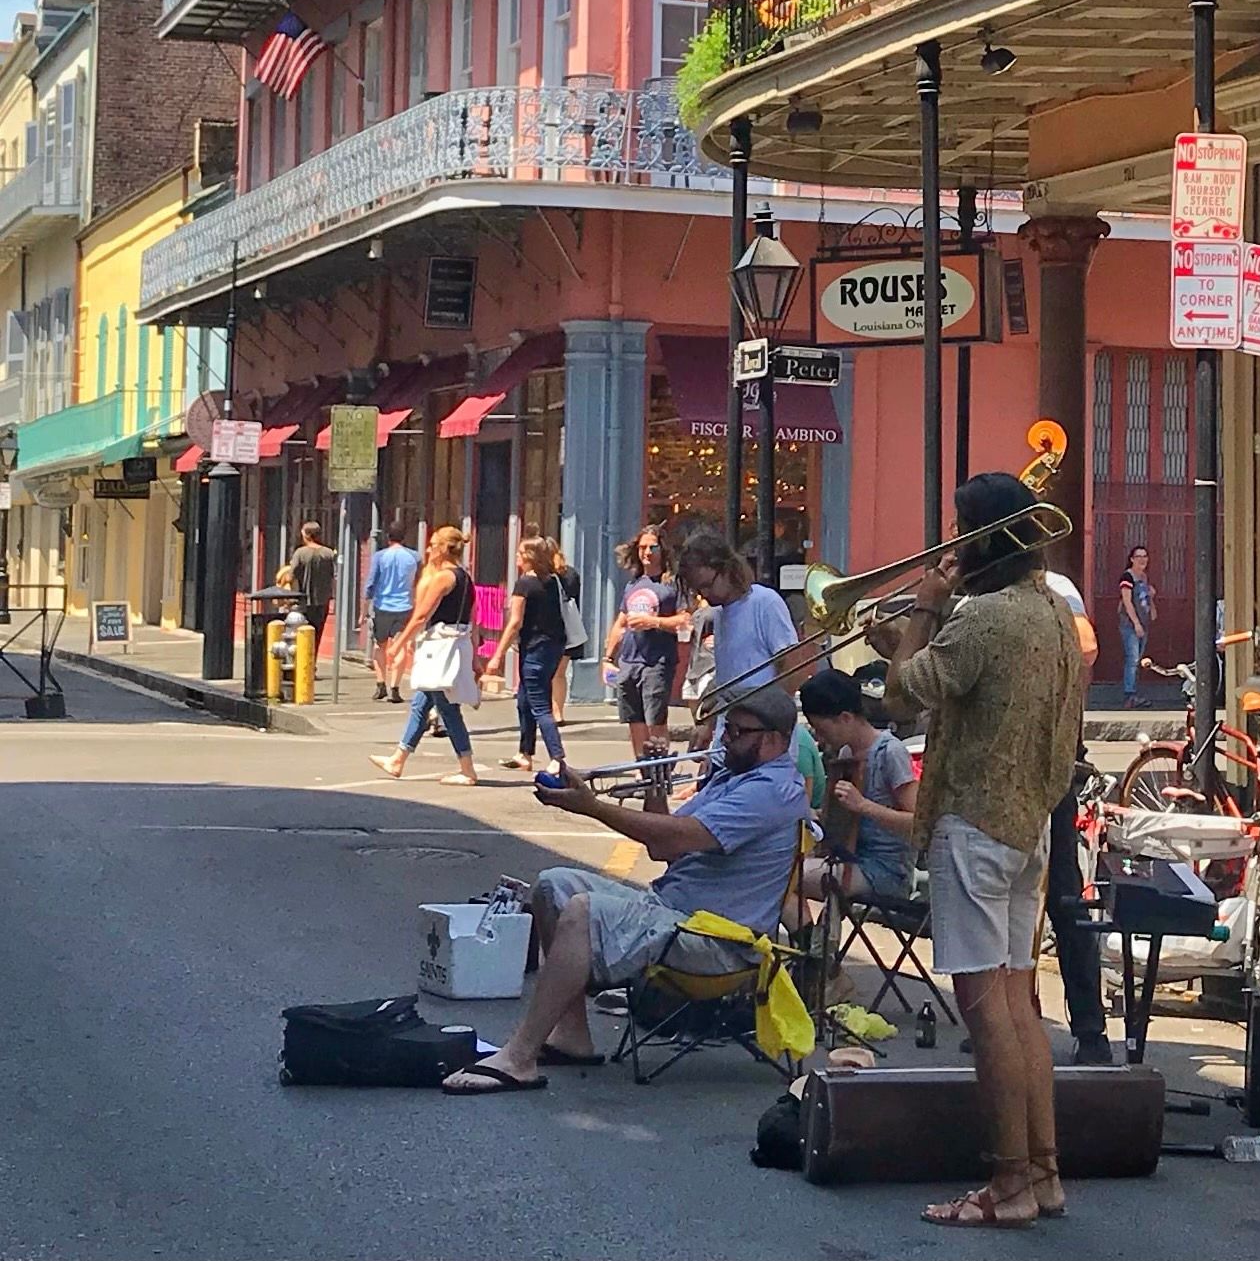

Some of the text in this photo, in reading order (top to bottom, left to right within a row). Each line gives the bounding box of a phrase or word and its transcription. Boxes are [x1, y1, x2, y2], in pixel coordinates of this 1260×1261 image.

[1177, 141, 1242, 164] NO STOPPING
[1213, 173, 1236, 186] NOON
[1185, 185, 1232, 197] THURSDAY
[1190, 196, 1227, 207] STREET
[1182, 206, 1233, 217] CLEANING
[1174, 248, 1240, 270] NO STOPPING
[1199, 278, 1215, 291] TO
[1179, 293, 1233, 307] CORNER
[905, 304, 957, 318] MAET
[853, 321, 904, 332] Louisiana
[1177, 326, 1235, 340] ANYTIME
[786, 359, 838, 379] Peter
[775, 428, 838, 443] AMBINO
[99, 624, 126, 638] SALE
